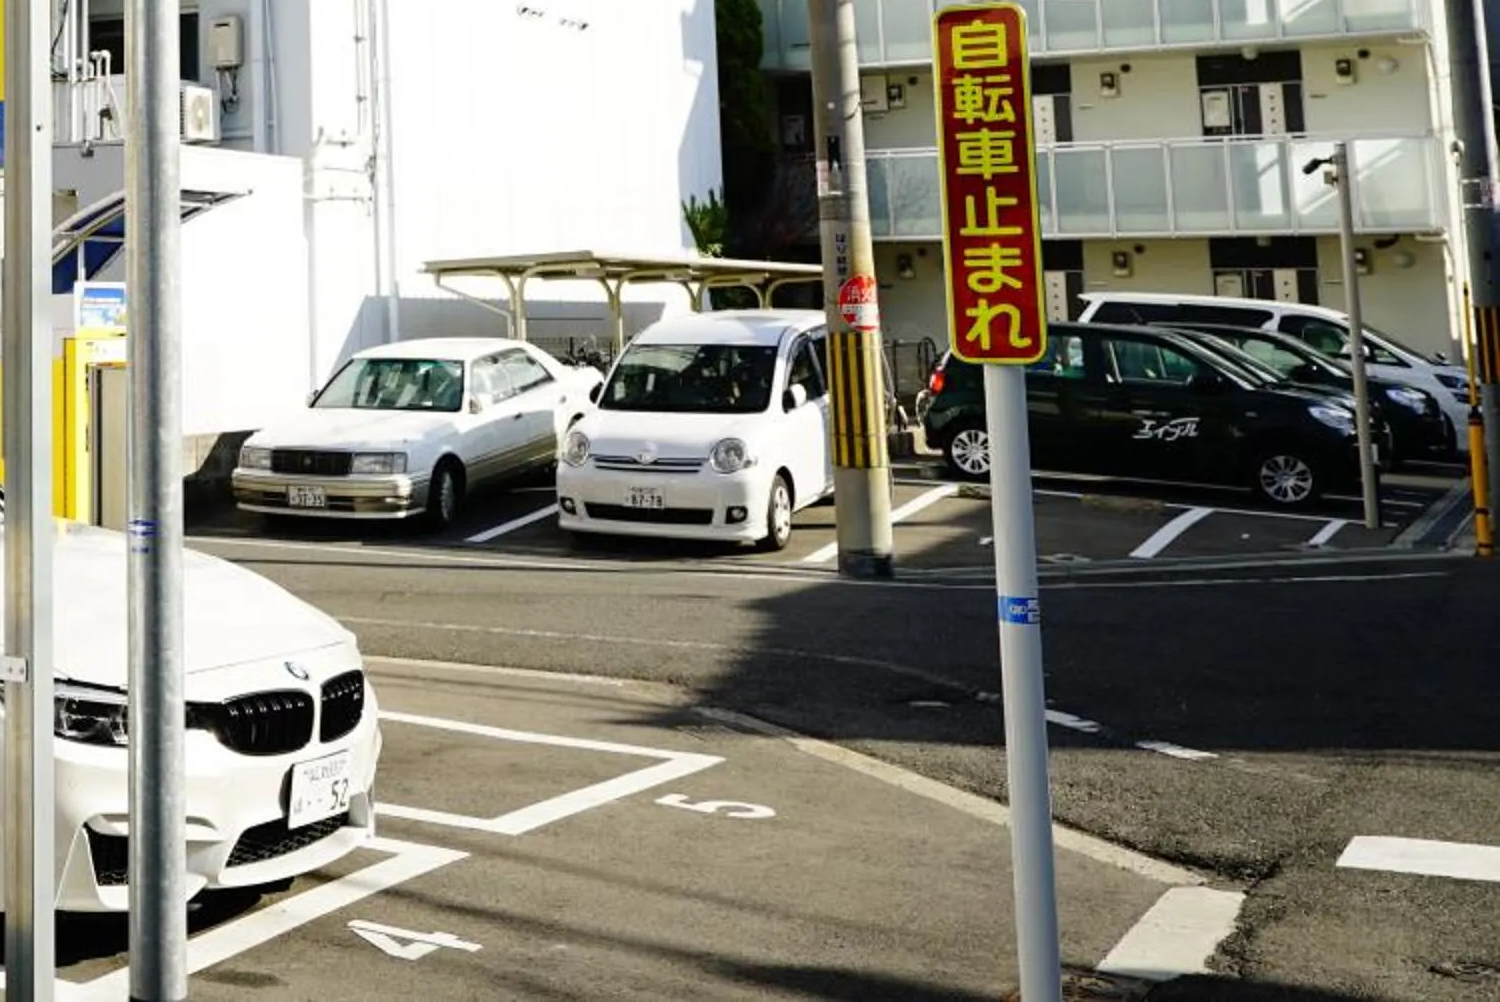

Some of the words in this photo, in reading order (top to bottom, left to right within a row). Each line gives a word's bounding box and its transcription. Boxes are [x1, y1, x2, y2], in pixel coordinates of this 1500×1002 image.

[951, 20, 1031, 351] 自転車止まれ
[1132, 417, 1200, 441] エイブル
